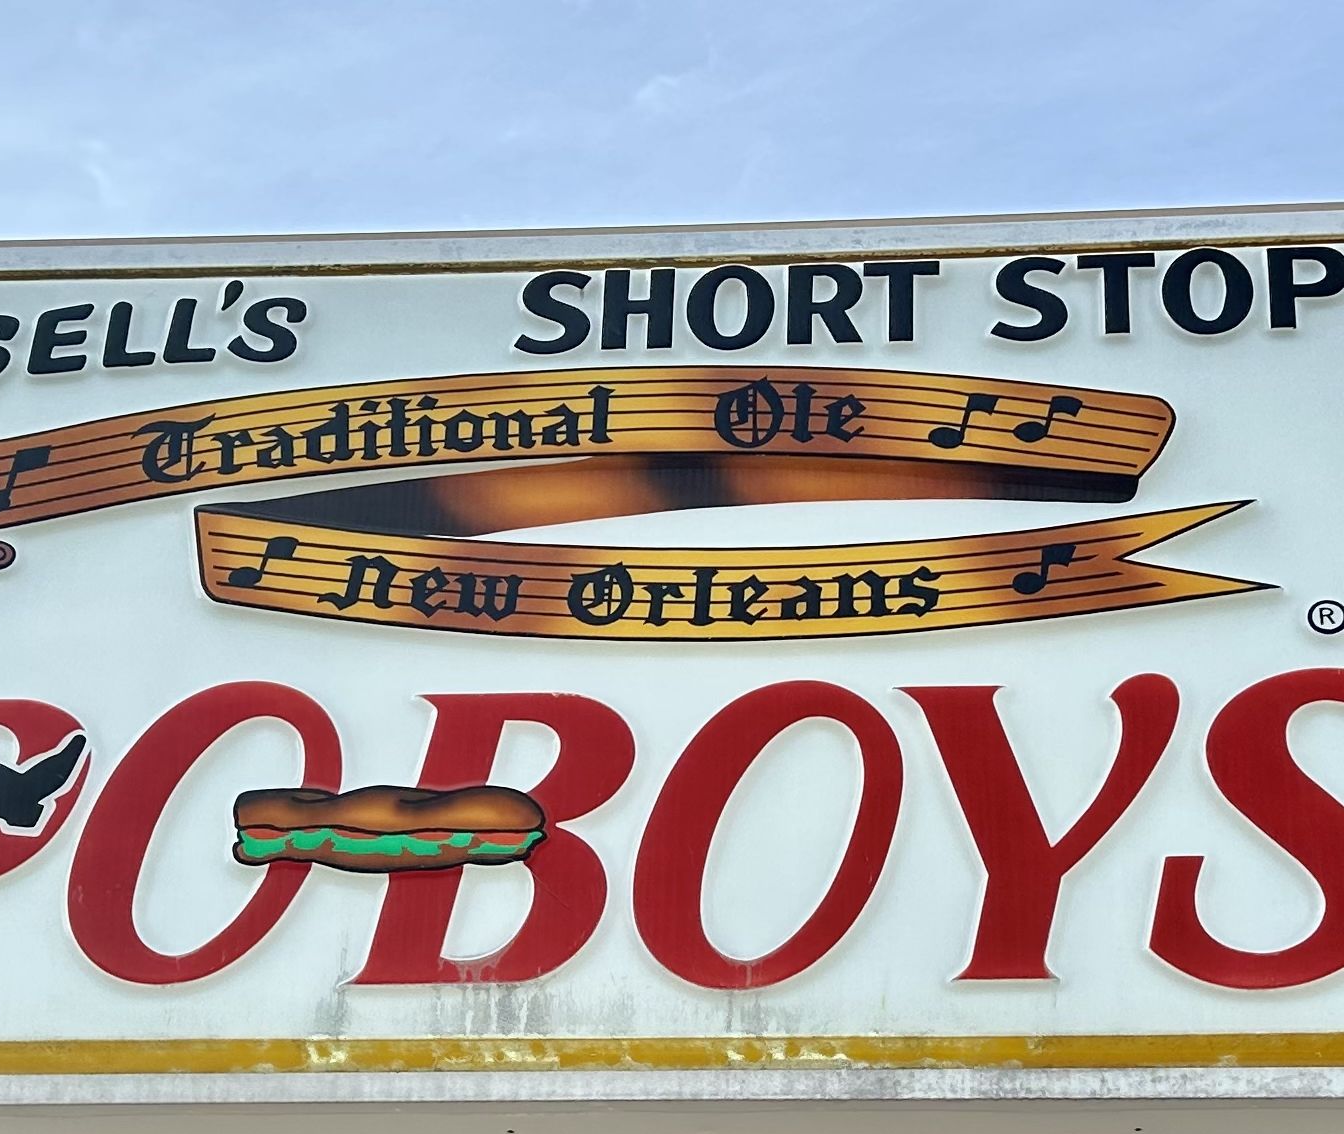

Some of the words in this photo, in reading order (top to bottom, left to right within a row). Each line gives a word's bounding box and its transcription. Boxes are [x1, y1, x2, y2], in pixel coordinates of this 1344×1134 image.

[513, 261, 941, 354] SHORT
[132, 385, 615, 484] Traditional
[713, 376, 868, 449] Ole
[317, 553, 524, 622] New
[568, 561, 942, 628] Orleans
